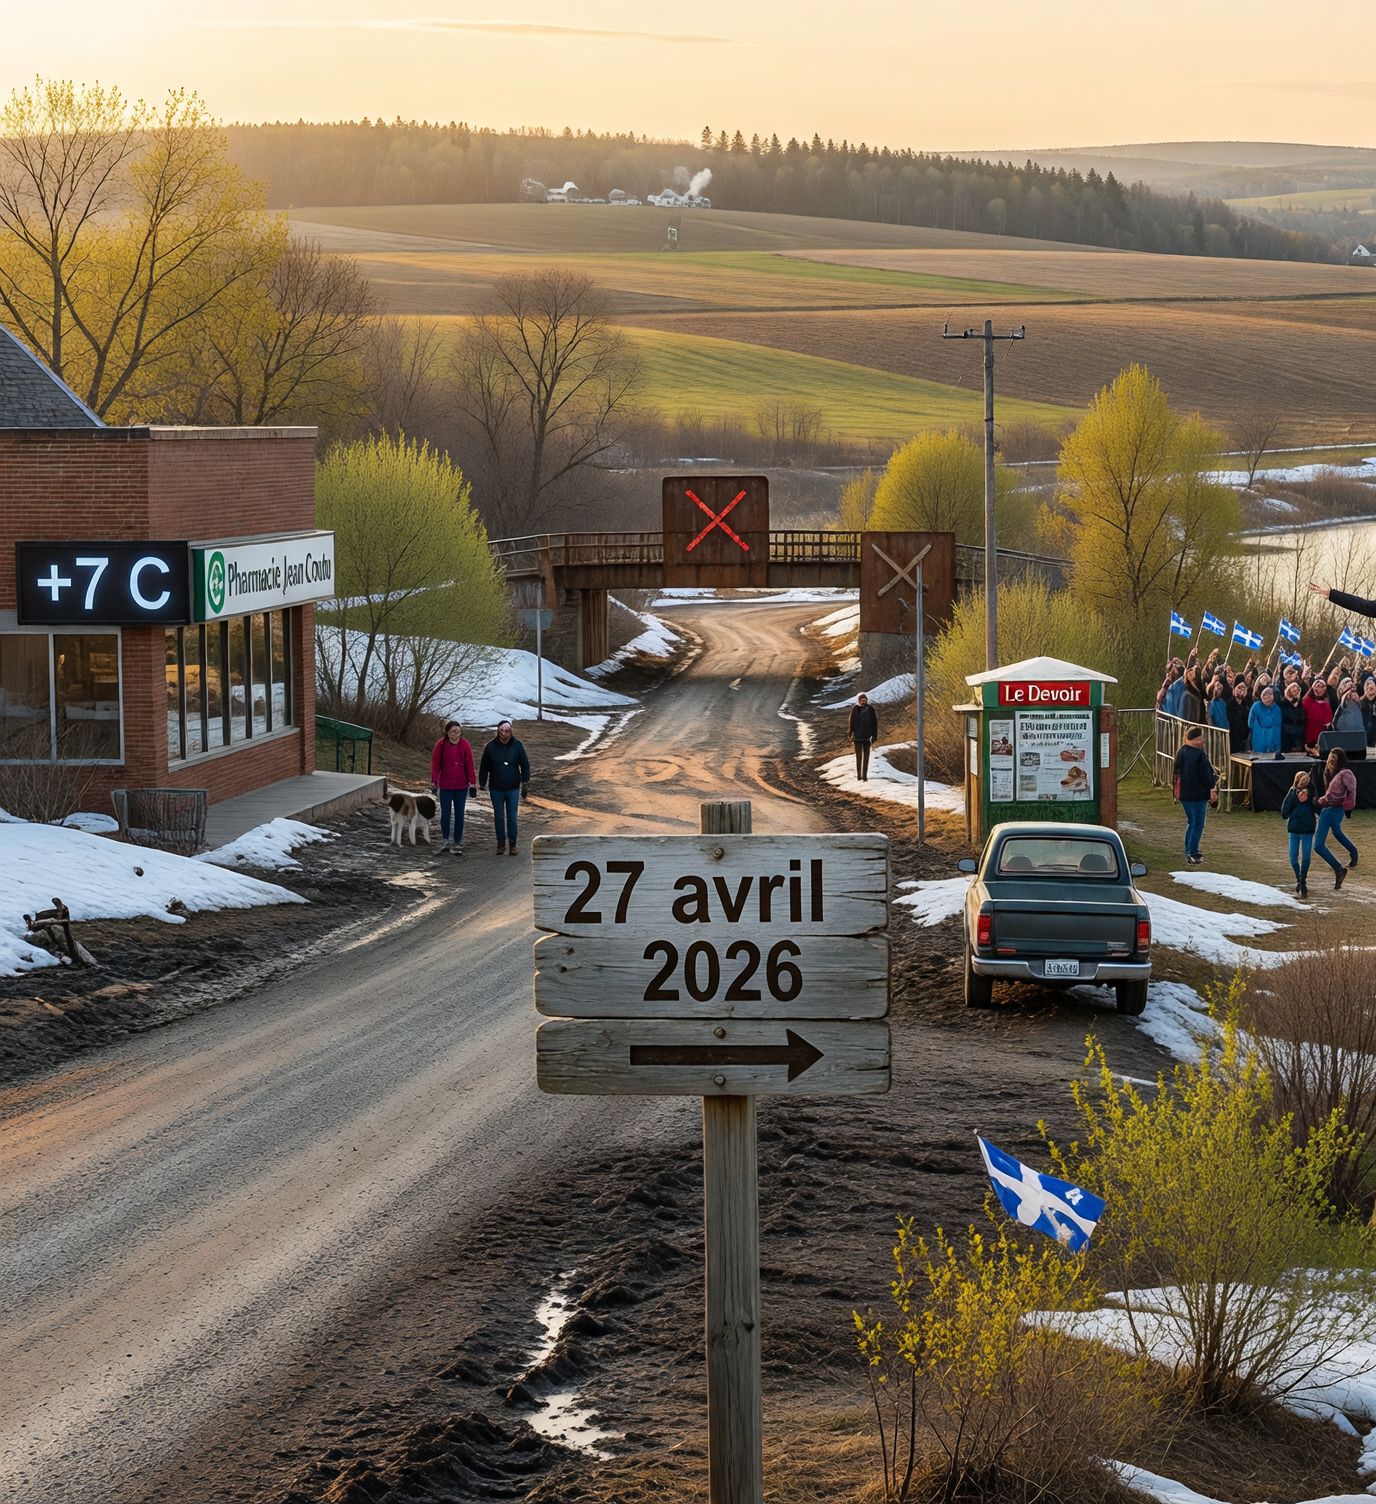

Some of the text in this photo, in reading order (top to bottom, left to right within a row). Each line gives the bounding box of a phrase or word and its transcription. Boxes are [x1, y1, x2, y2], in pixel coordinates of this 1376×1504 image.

[37, 556, 171, 610] +7 C
[227, 552, 332, 597] Pharmacie Jean Coutu
[1004, 684, 1082, 702] Le Devoir
[564, 859, 824, 925] 27 avril
[642, 939, 803, 1003] 2026
